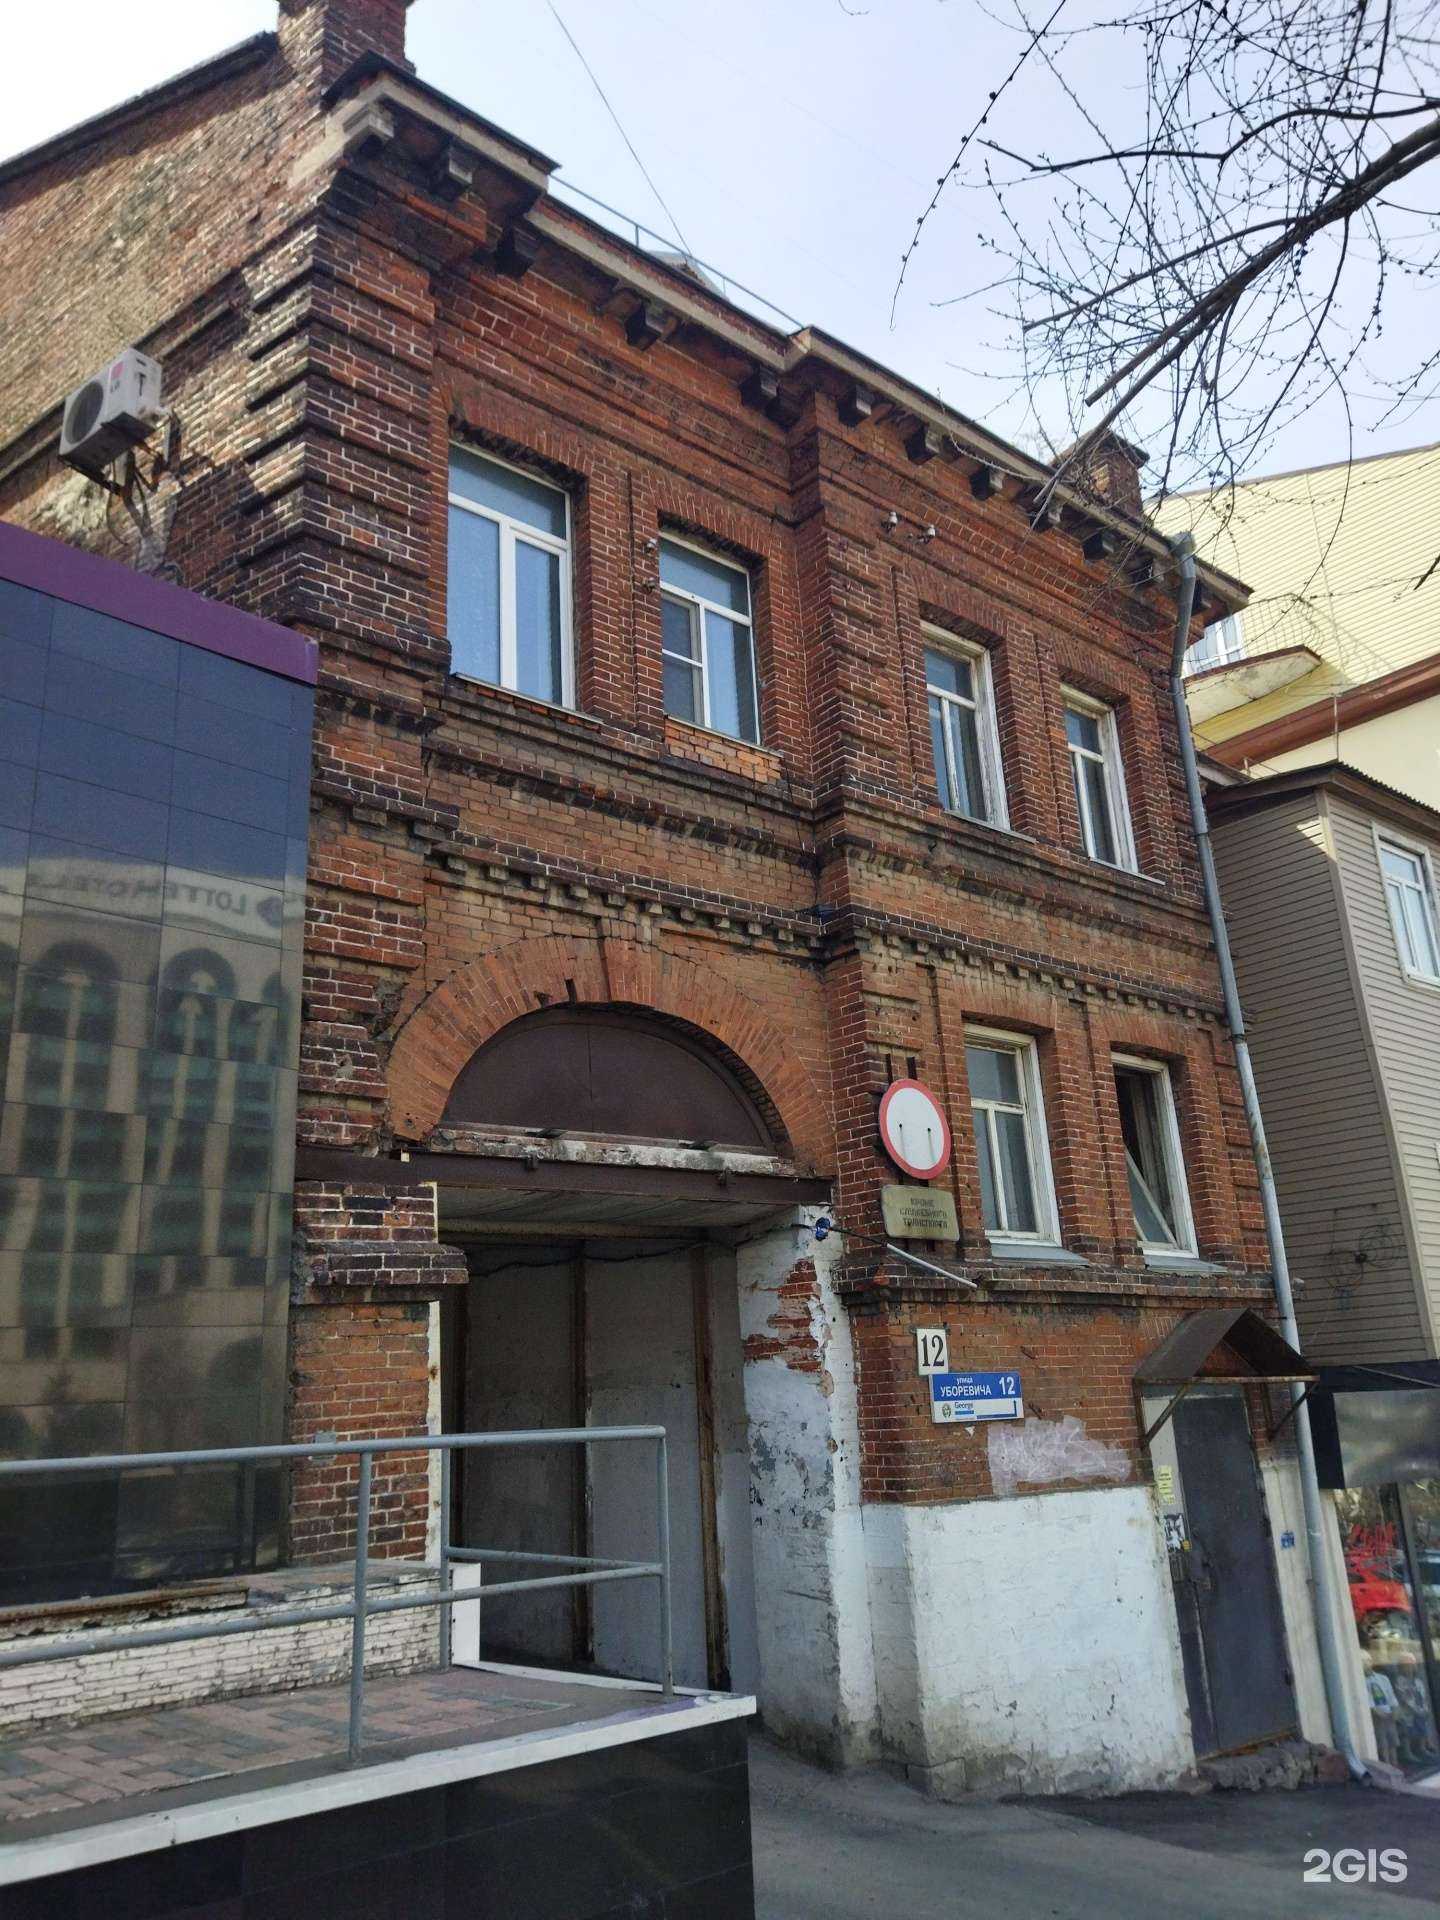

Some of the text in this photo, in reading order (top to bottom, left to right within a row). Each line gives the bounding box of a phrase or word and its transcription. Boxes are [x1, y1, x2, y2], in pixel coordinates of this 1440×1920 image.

[921, 1334, 945, 1367] 12
[940, 1376, 1016, 1397] УБОРЕВИЧА 12
[957, 1377, 973, 1386] улица
